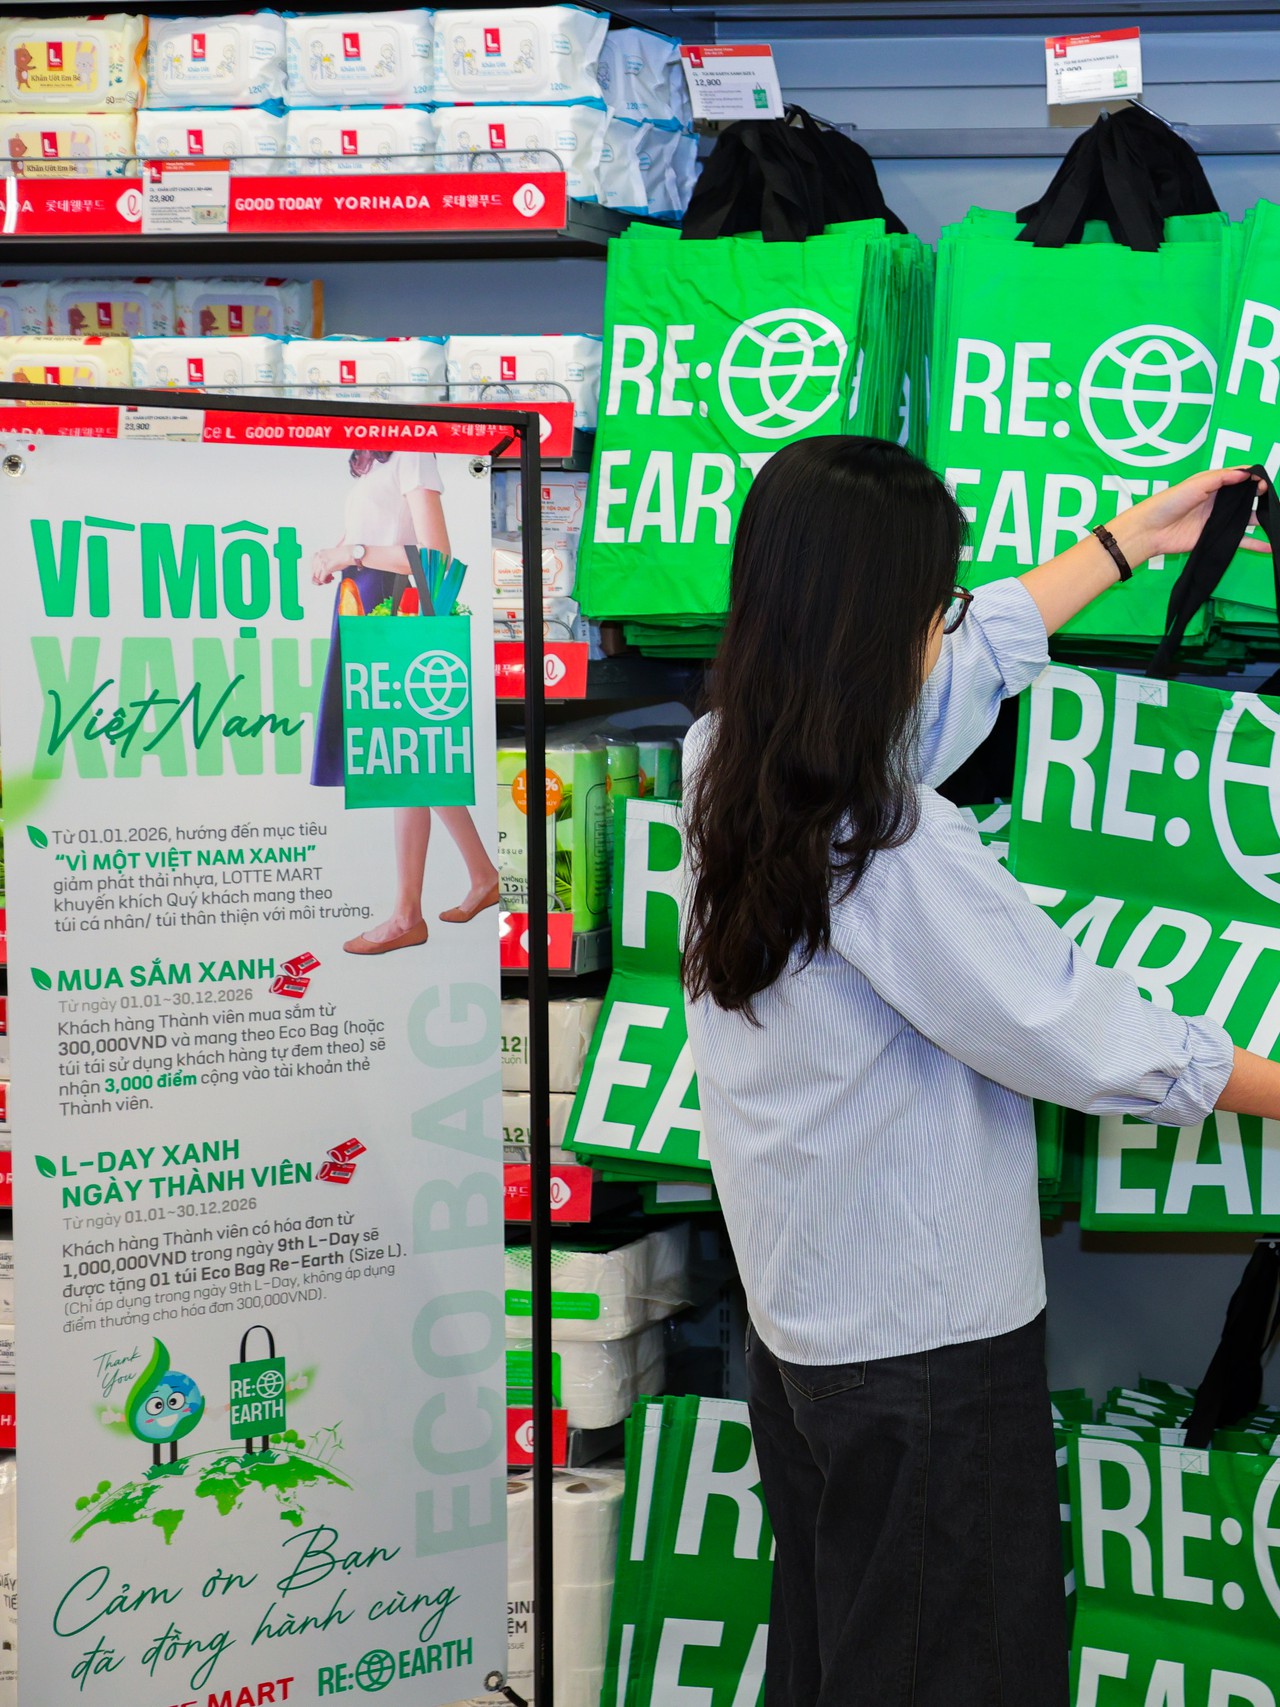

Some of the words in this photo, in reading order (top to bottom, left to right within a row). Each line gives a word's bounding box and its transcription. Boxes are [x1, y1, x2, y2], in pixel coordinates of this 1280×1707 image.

[695, 79, 721, 87] 12,900
[235, 198, 274, 211] GOOD
[278, 197, 322, 210] TODAY
[334, 196, 430, 209] YORIHADA
[605, 324, 712, 417] RE:
[949, 338, 1071, 438] RE:
[246, 426, 284, 439] GOOD
[288, 426, 332, 438] TODAY
[344, 425, 438, 437] YORIHADA
[594, 450, 773, 544] EAR
[30, 515, 136, 618] Vì
[140, 520, 304, 638] Một
[345, 663, 402, 710] RE:
[47, 678, 180, 758] Việt
[143, 674, 304, 751] Nam
[347, 726, 472, 775] EARTH
[1021, 666, 1200, 848] RE:
[52, 829, 75, 844] Từ
[78, 827, 171, 843] 01.01.2026,
[176, 825, 226, 841] hướng
[231, 822, 258, 838] đến
[263, 826, 294, 839] mục
[299, 821, 326, 835] tiêu
[93, 849, 140, 874] MỘT
[145, 847, 191, 871] VIỆT
[197, 849, 244, 865] NAM
[54, 876, 92, 894] giảm
[97, 874, 134, 892] phát
[138, 872, 168, 887] thải
[173, 872, 217, 888] nhựa,
[222, 869, 271, 884] LOTTE
[276, 867, 322, 881] MART
[54, 894, 114, 913] khuyến
[119, 893, 162, 908] khích
[166, 891, 197, 908] Quý
[202, 889, 249, 904] khách
[254, 890, 294, 903] mang
[299, 887, 332, 899] theo
[54, 917, 75, 931] túi
[80, 915, 99, 930] cá
[104, 913, 151, 929] nhân/
[156, 912, 175, 926] túi
[180, 910, 215, 925] thân
[220, 908, 258, 925] thiện
[263, 906, 284, 920] với
[289, 905, 314, 919] môi
[319, 903, 373, 919] trường.
[58, 967, 123, 991] MUA
[130, 957, 191, 986] SẮM
[199, 958, 274, 982] XANH
[58, 999, 78, 1012] Từ
[82, 997, 116, 1013] ngày
[120, 988, 252, 1008] 01.01~30.12.2026
[58, 1019, 109, 1035] Khách
[114, 1016, 154, 1032] hàng
[158, 1012, 208, 1027] Thành
[212, 1009, 244, 1023] viên
[249, 1010, 280, 1021] mua
[285, 1004, 314, 1019] sắm
[319, 1002, 336, 1016] từ
[58, 1035, 166, 1055] 300,000VND
[171, 1032, 189, 1046] và
[194, 1032, 236, 1045] mang
[241, 1028, 274, 1041] theo
[279, 1025, 305, 1038] Eco
[310, 1023, 337, 1037] Bag
[344, 1019, 384, 1034] (hoặc
[60, 1080, 99, 1095] nhận
[105, 1075, 152, 1093] 3,000
[157, 1070, 196, 1087] điểm
[201, 1069, 237, 1084] cộng
[243, 1066, 269, 1079] vào
[274, 1067, 292, 1077] tài
[297, 1060, 341, 1075] khoản
[346, 1057, 369, 1071] thẻ
[59, 1099, 111, 1115] Thành
[115, 1095, 152, 1110] viên.
[62, 1147, 154, 1176] L-DAY
[162, 1139, 238, 1166] XANH
[62, 1177, 142, 1208] NGÀY
[149, 1169, 244, 1198] THÀNH
[251, 1159, 311, 1187] VIÊN
[63, 1216, 83, 1229] Từ
[86, 1212, 120, 1229] ngày
[125, 1197, 256, 1223] 01.01~30.12.2026
[63, 1250, 186, 1279] 1,000,000VND
[191, 1248, 232, 1261] trong
[236, 1240, 273, 1258] ngày
[278, 1236, 303, 1251] 9th
[308, 1232, 359, 1248] L-Day
[363, 1227, 378, 1241] sẽ
[63, 1283, 104, 1297] được
[109, 1277, 145, 1294] tặng
[150, 1272, 170, 1286] 01
[174, 1268, 196, 1283] túi
[202, 1266, 230, 1280] Eco
[235, 1263, 264, 1276] Bag
[270, 1251, 343, 1272] Re-Earth
[350, 1247, 384, 1263] (Size
[388, 1243, 406, 1257] L).
[94, 1346, 142, 1372] Thank
[103, 1370, 137, 1399] You
[231, 1377, 256, 1399] RE:
[231, 1401, 284, 1424] EARTH
[1077, 1437, 1246, 1611] RE:
[53, 1566, 183, 1638] Cảm
[202, 1571, 257, 1597] ơn
[276, 1525, 400, 1597] Bạn
[71, 1636, 125, 1691] đã
[142, 1623, 236, 1690] đồng
[252, 1589, 354, 1645] hành
[369, 1586, 461, 1643] cùng
[318, 1662, 353, 1697] RE:
[399, 1637, 473, 1679] EARTH
[208, 1677, 294, 1707] MART
